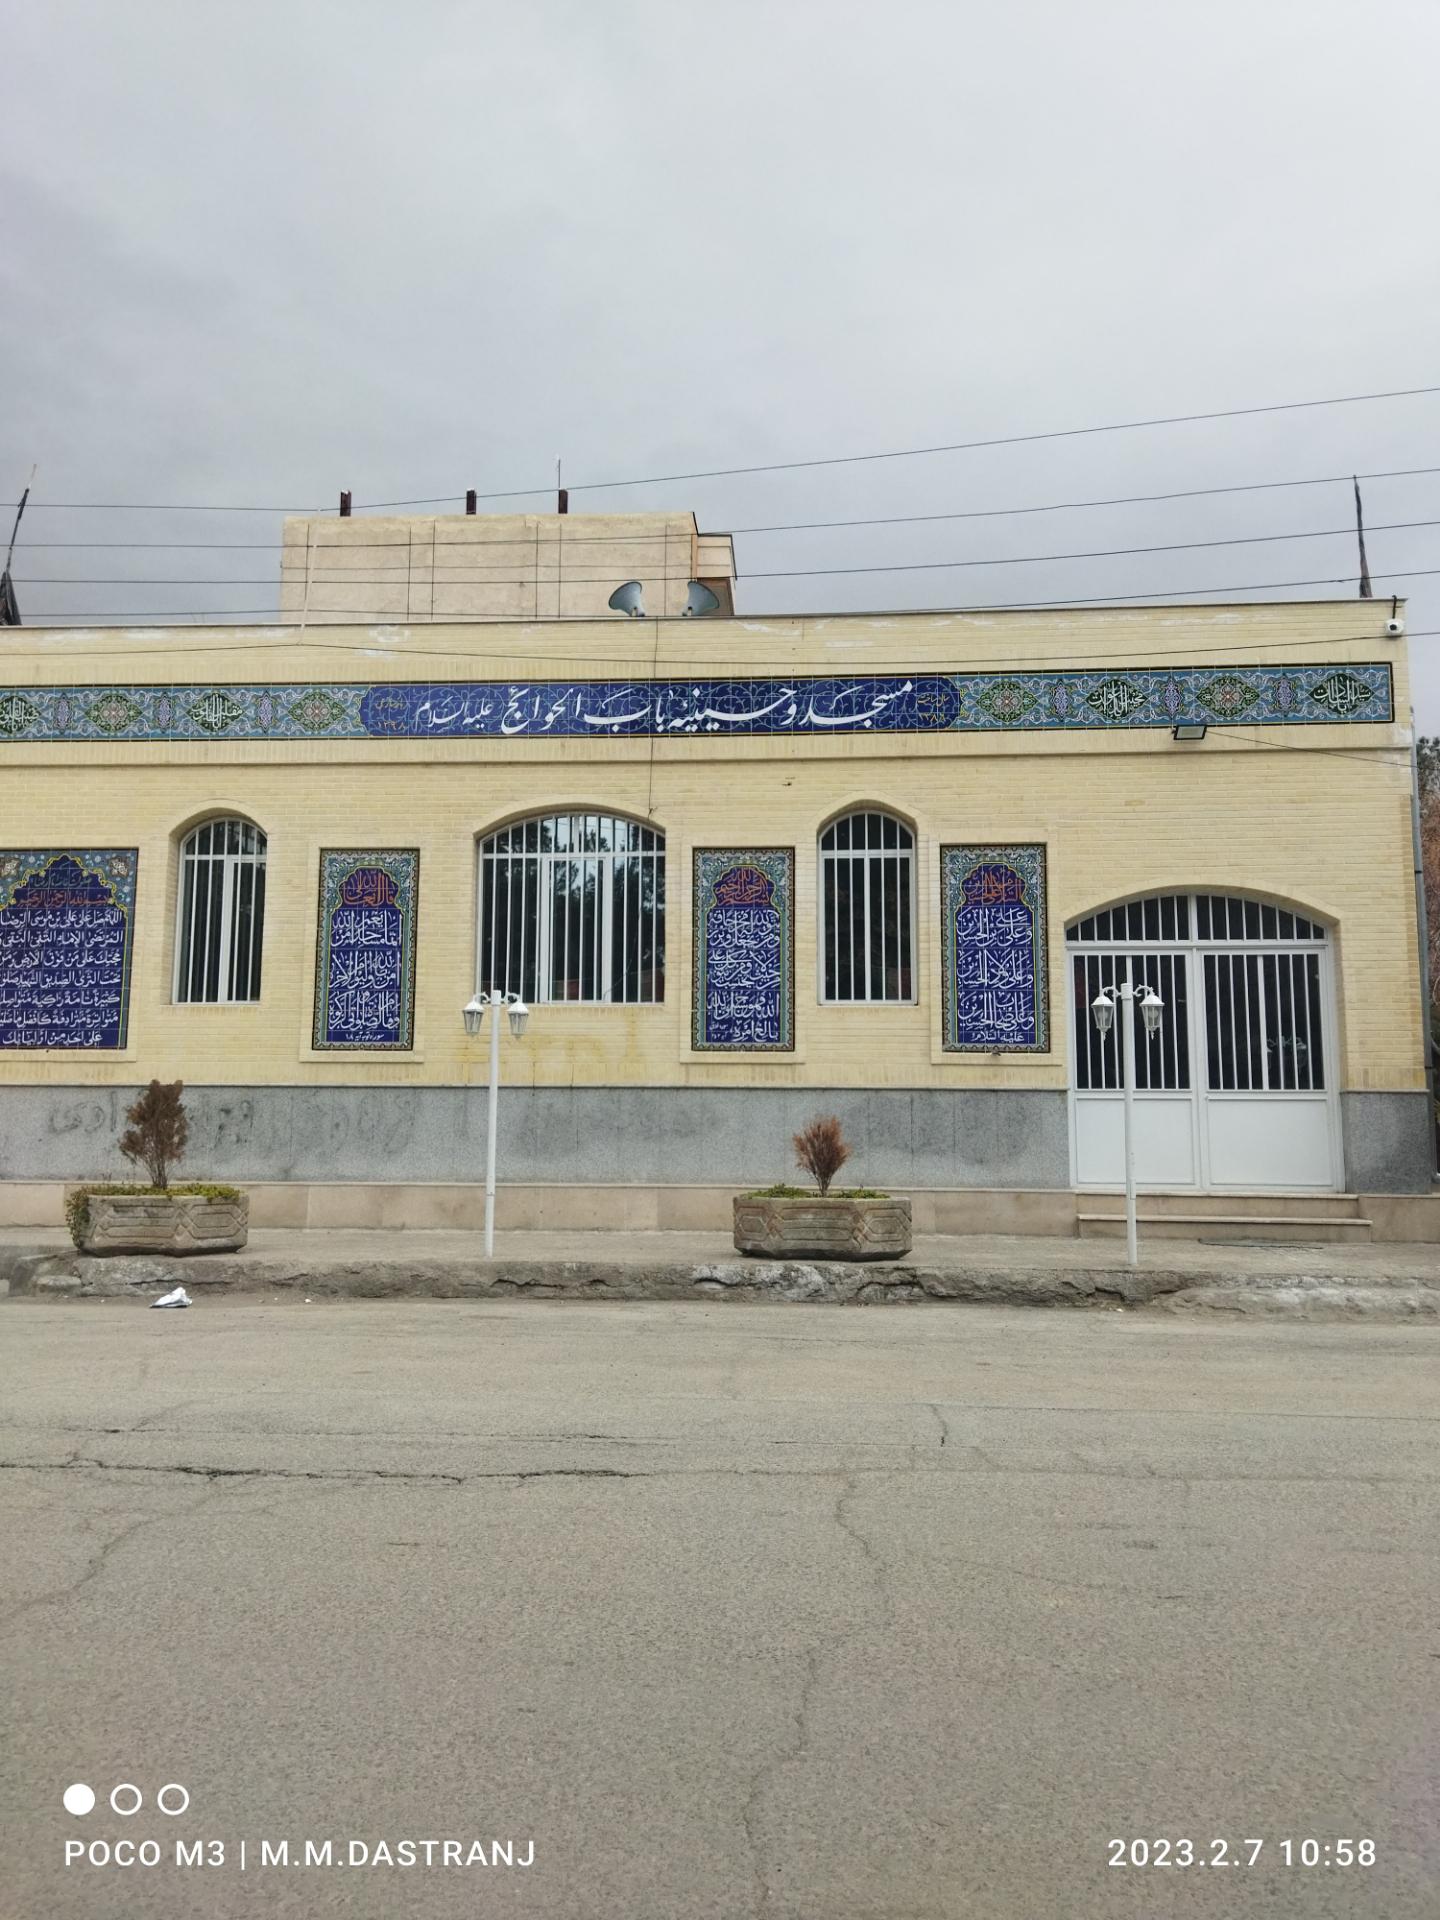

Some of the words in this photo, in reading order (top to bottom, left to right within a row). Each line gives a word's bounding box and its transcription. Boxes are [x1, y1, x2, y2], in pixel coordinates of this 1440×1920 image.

[416, 696, 469, 732] السلام
[463, 698, 493, 728] علیه
[584, 688, 664, 733] باب
[799, 680, 913, 728] مسجد
